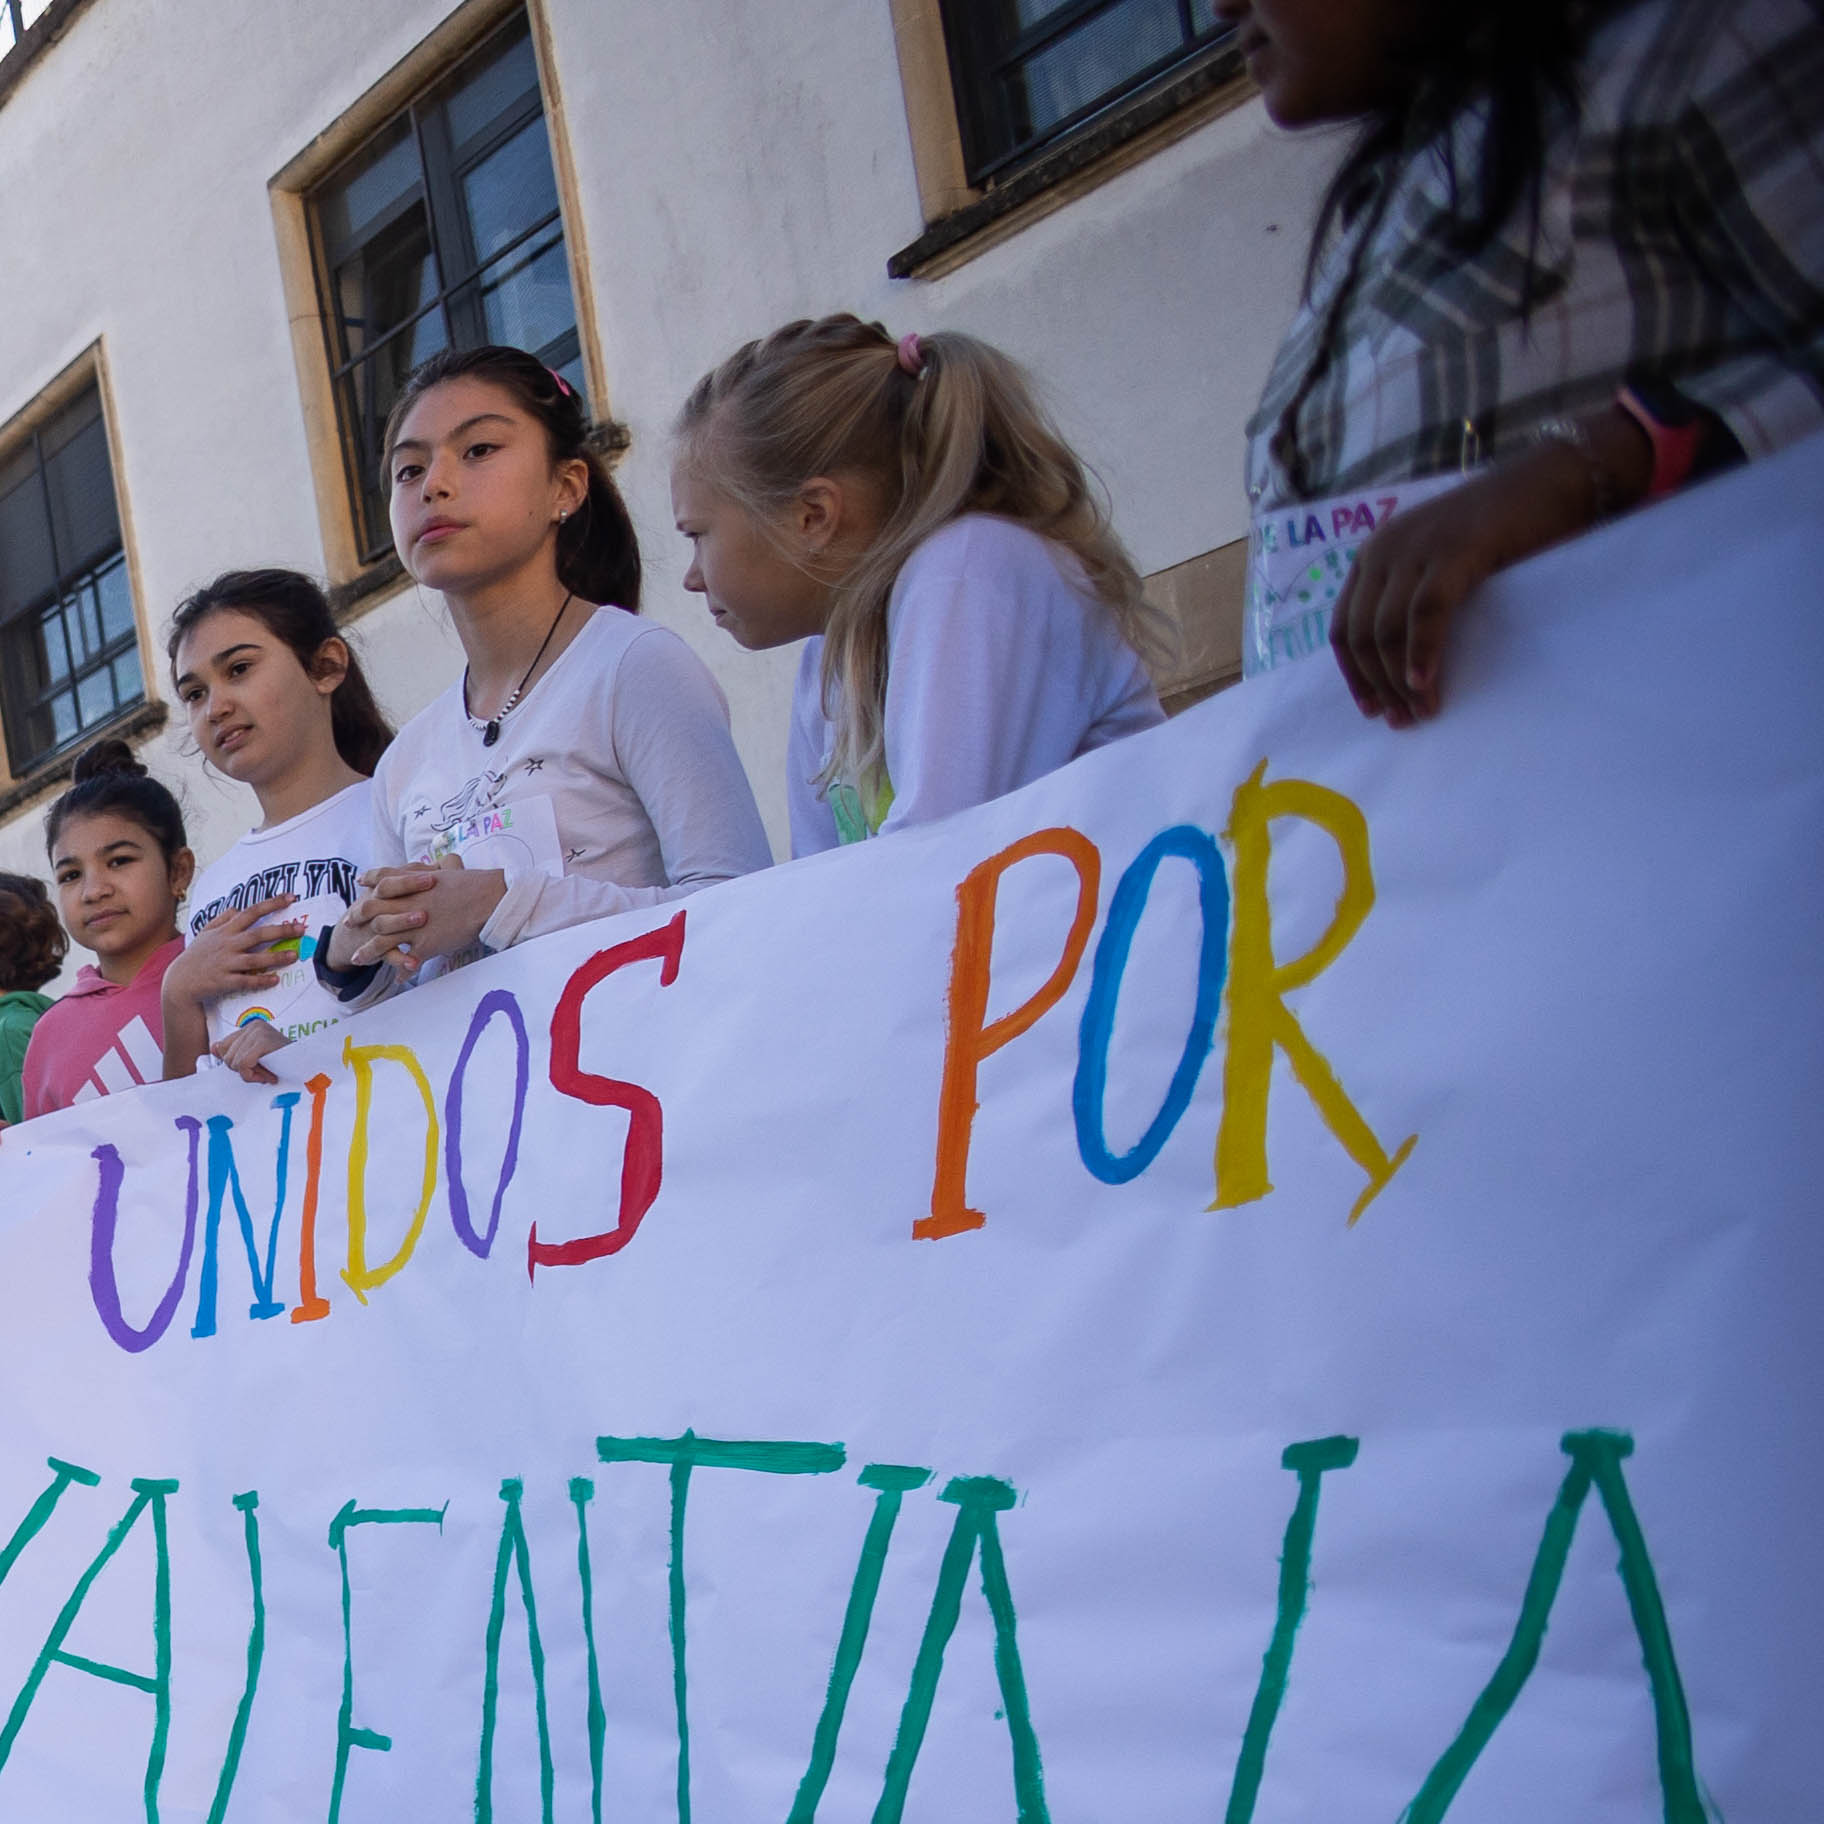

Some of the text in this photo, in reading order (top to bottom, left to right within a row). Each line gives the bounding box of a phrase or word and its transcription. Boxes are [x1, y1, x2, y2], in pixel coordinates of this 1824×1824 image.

[1287, 514, 1326, 548] LA
[1331, 496, 1400, 539] PAZ
[458, 821, 475, 842] LA
[483, 808, 513, 834] PAZ
[88, 757, 1419, 1353] UNIDOS POR
